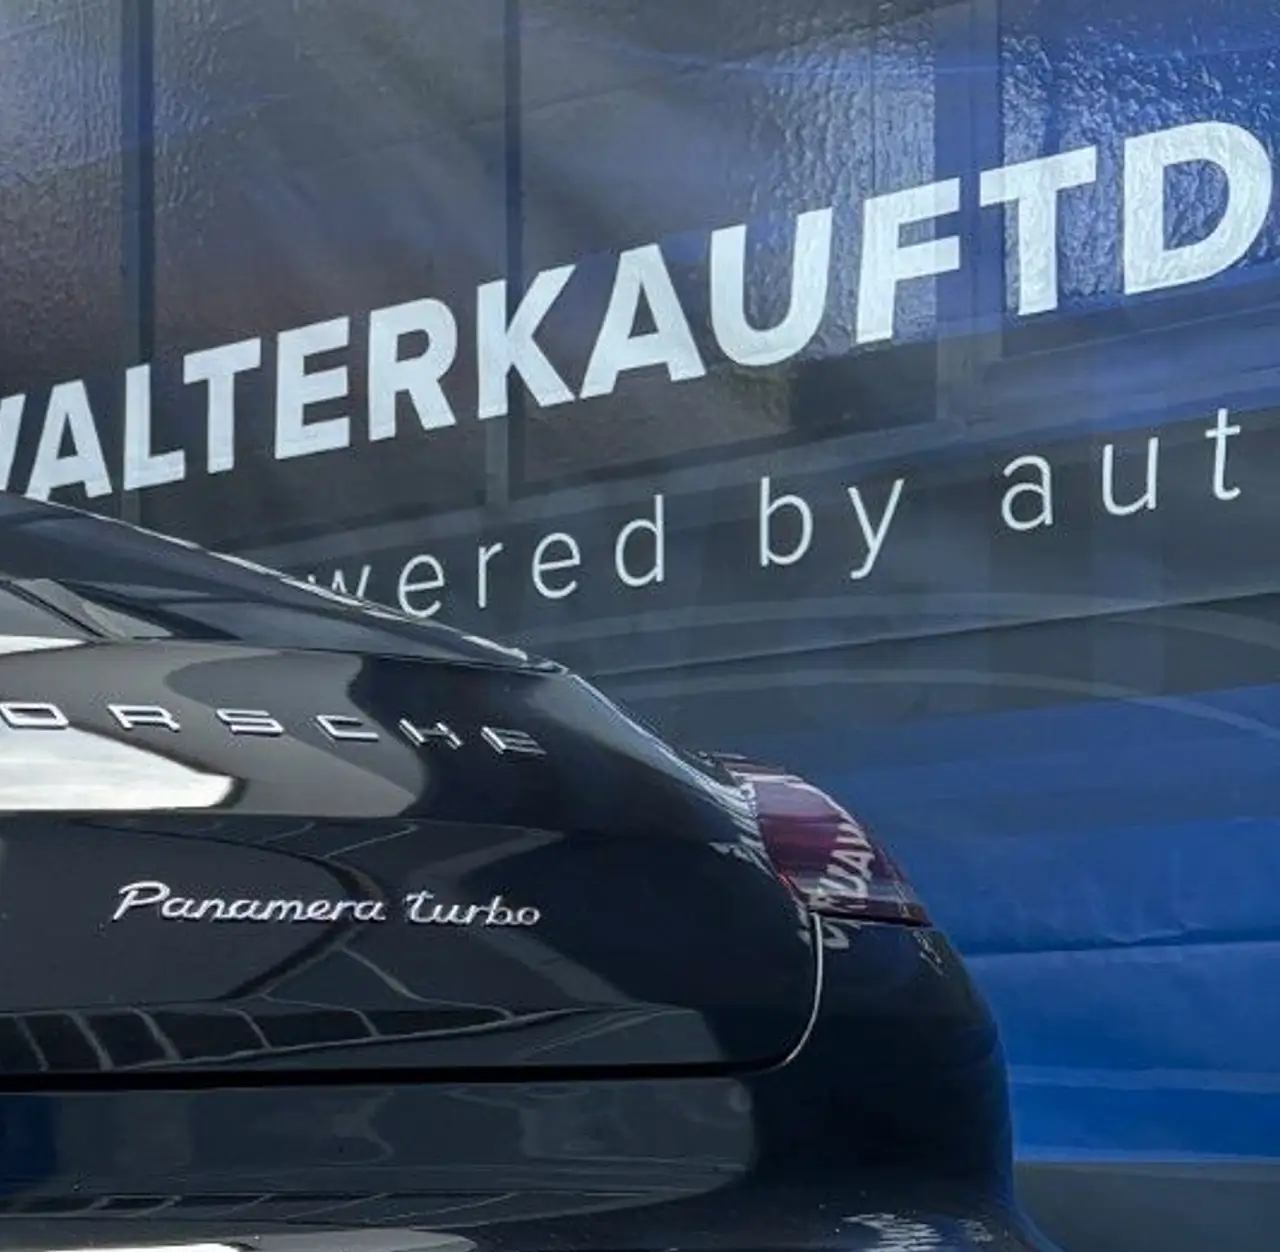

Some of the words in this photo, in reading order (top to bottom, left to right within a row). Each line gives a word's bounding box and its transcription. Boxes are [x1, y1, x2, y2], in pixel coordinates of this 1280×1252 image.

[760, 477, 904, 579] by
[1001, 408, 1241, 530] aut
[112, 880, 386, 922] Panamera
[404, 890, 541, 926] turbo
